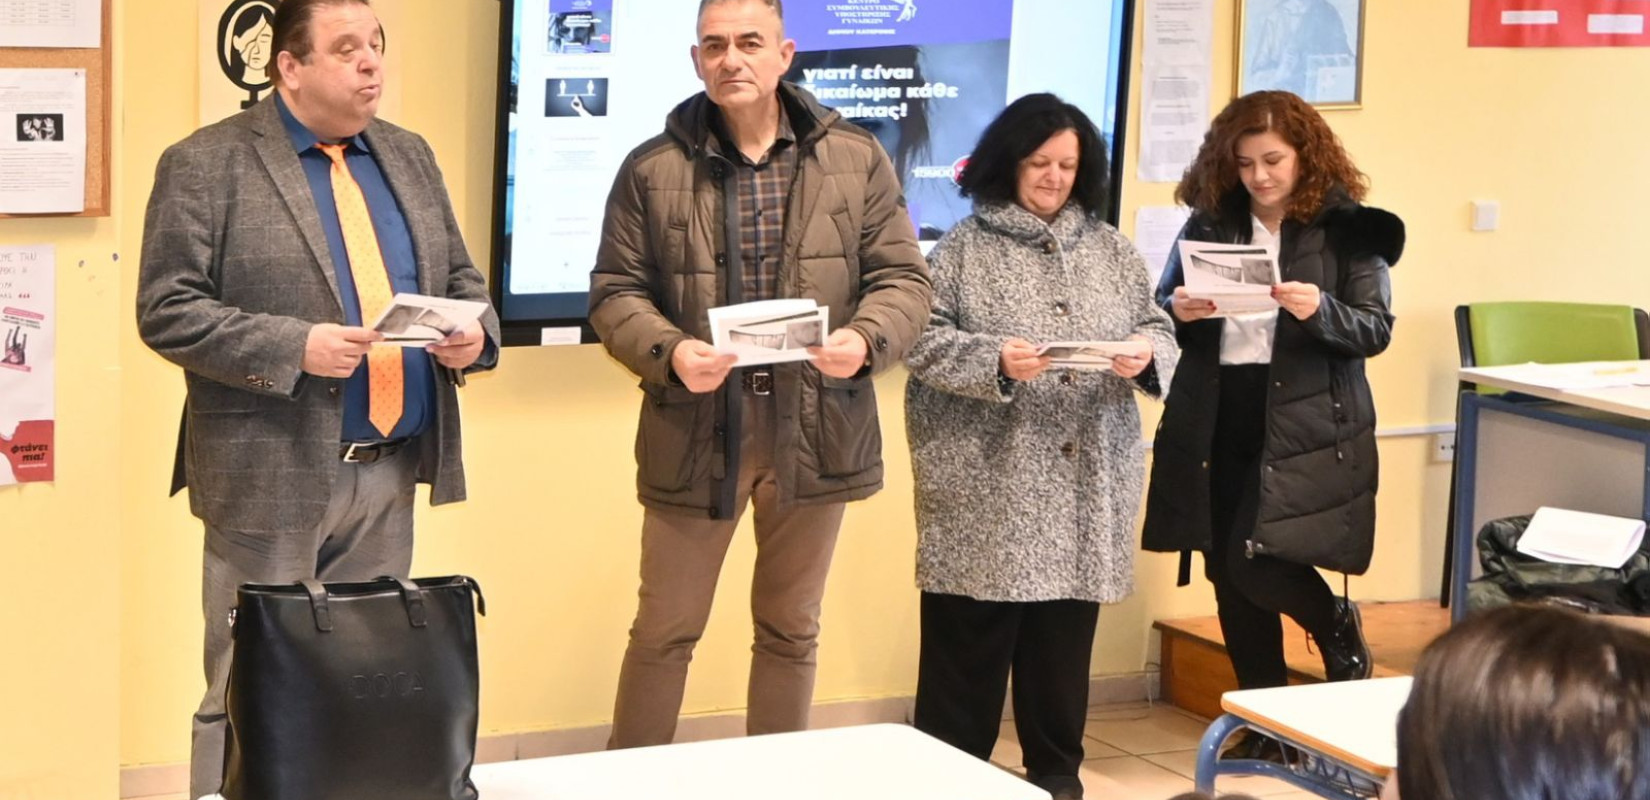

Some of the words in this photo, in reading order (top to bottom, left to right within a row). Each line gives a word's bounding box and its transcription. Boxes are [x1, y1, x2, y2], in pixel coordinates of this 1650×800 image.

[803, 64, 857, 82] γιατί
[861, 64, 914, 80] είναι
[906, 82, 959, 98] κάθε
